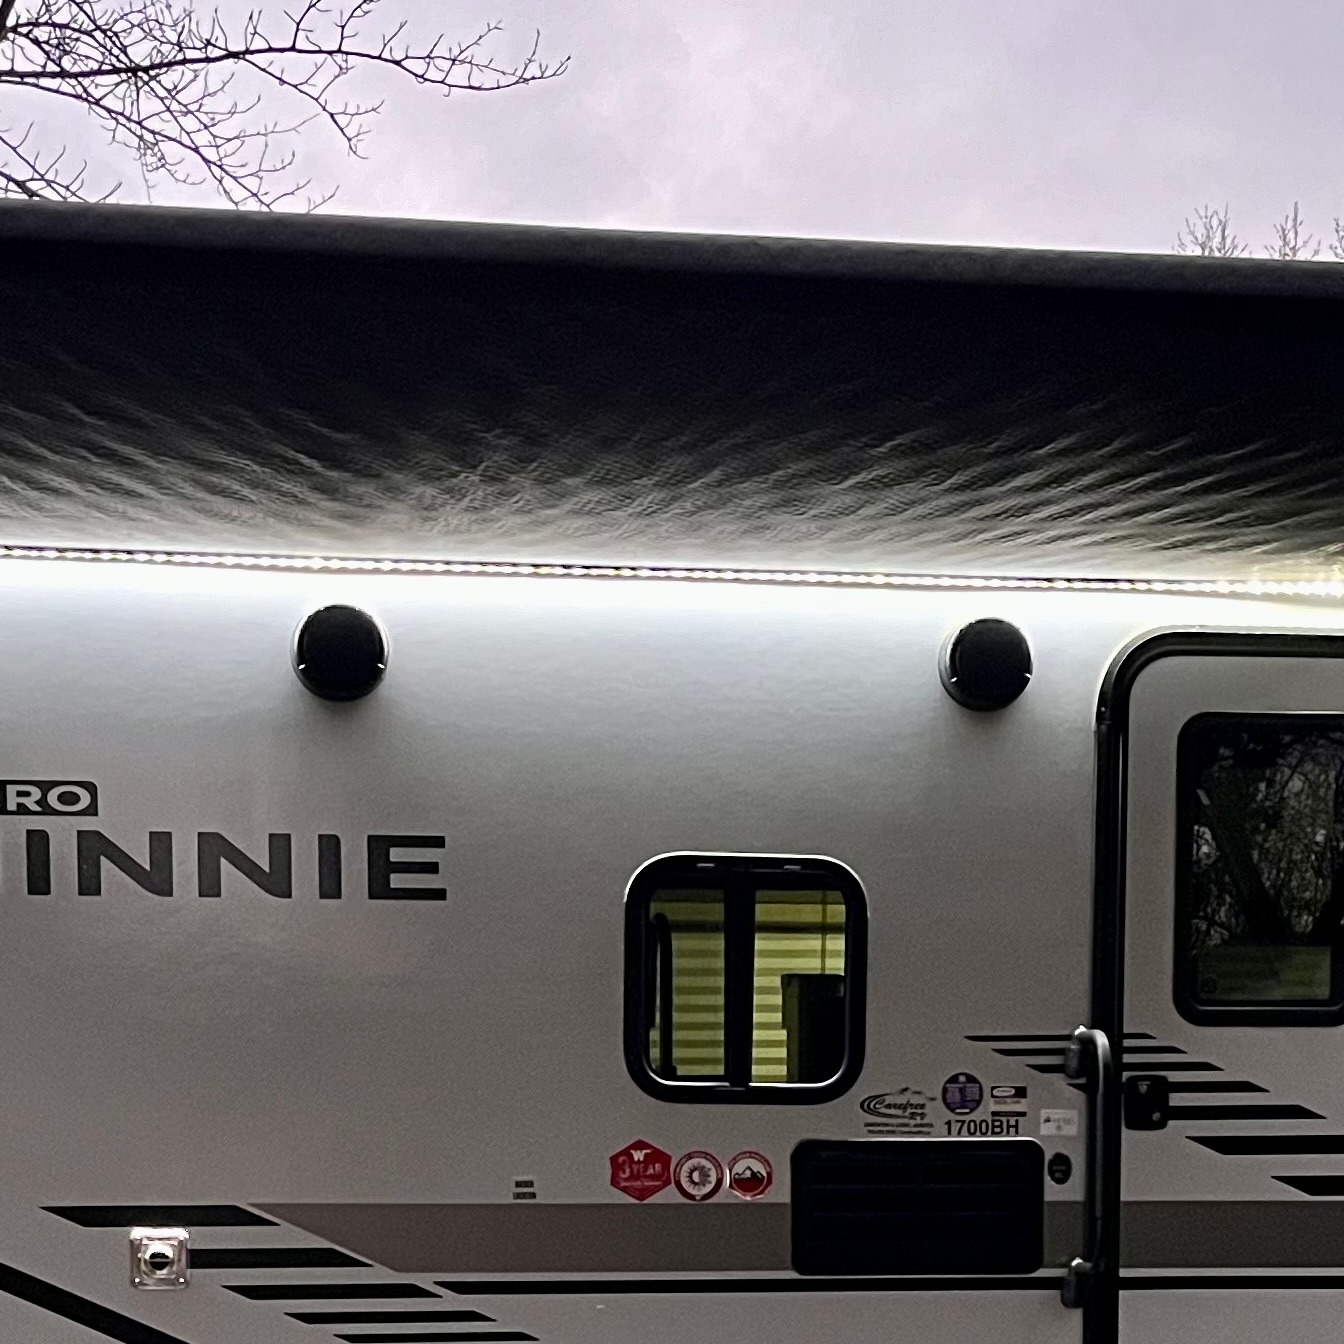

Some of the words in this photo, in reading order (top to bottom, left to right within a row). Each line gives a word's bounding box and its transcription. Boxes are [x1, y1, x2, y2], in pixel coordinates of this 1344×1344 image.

[872, 1097, 927, 1114] Carefree
[944, 1118, 1020, 1136] 1700BH
[618, 1155, 631, 1179] 3
[631, 1162, 663, 1176] YEAR
